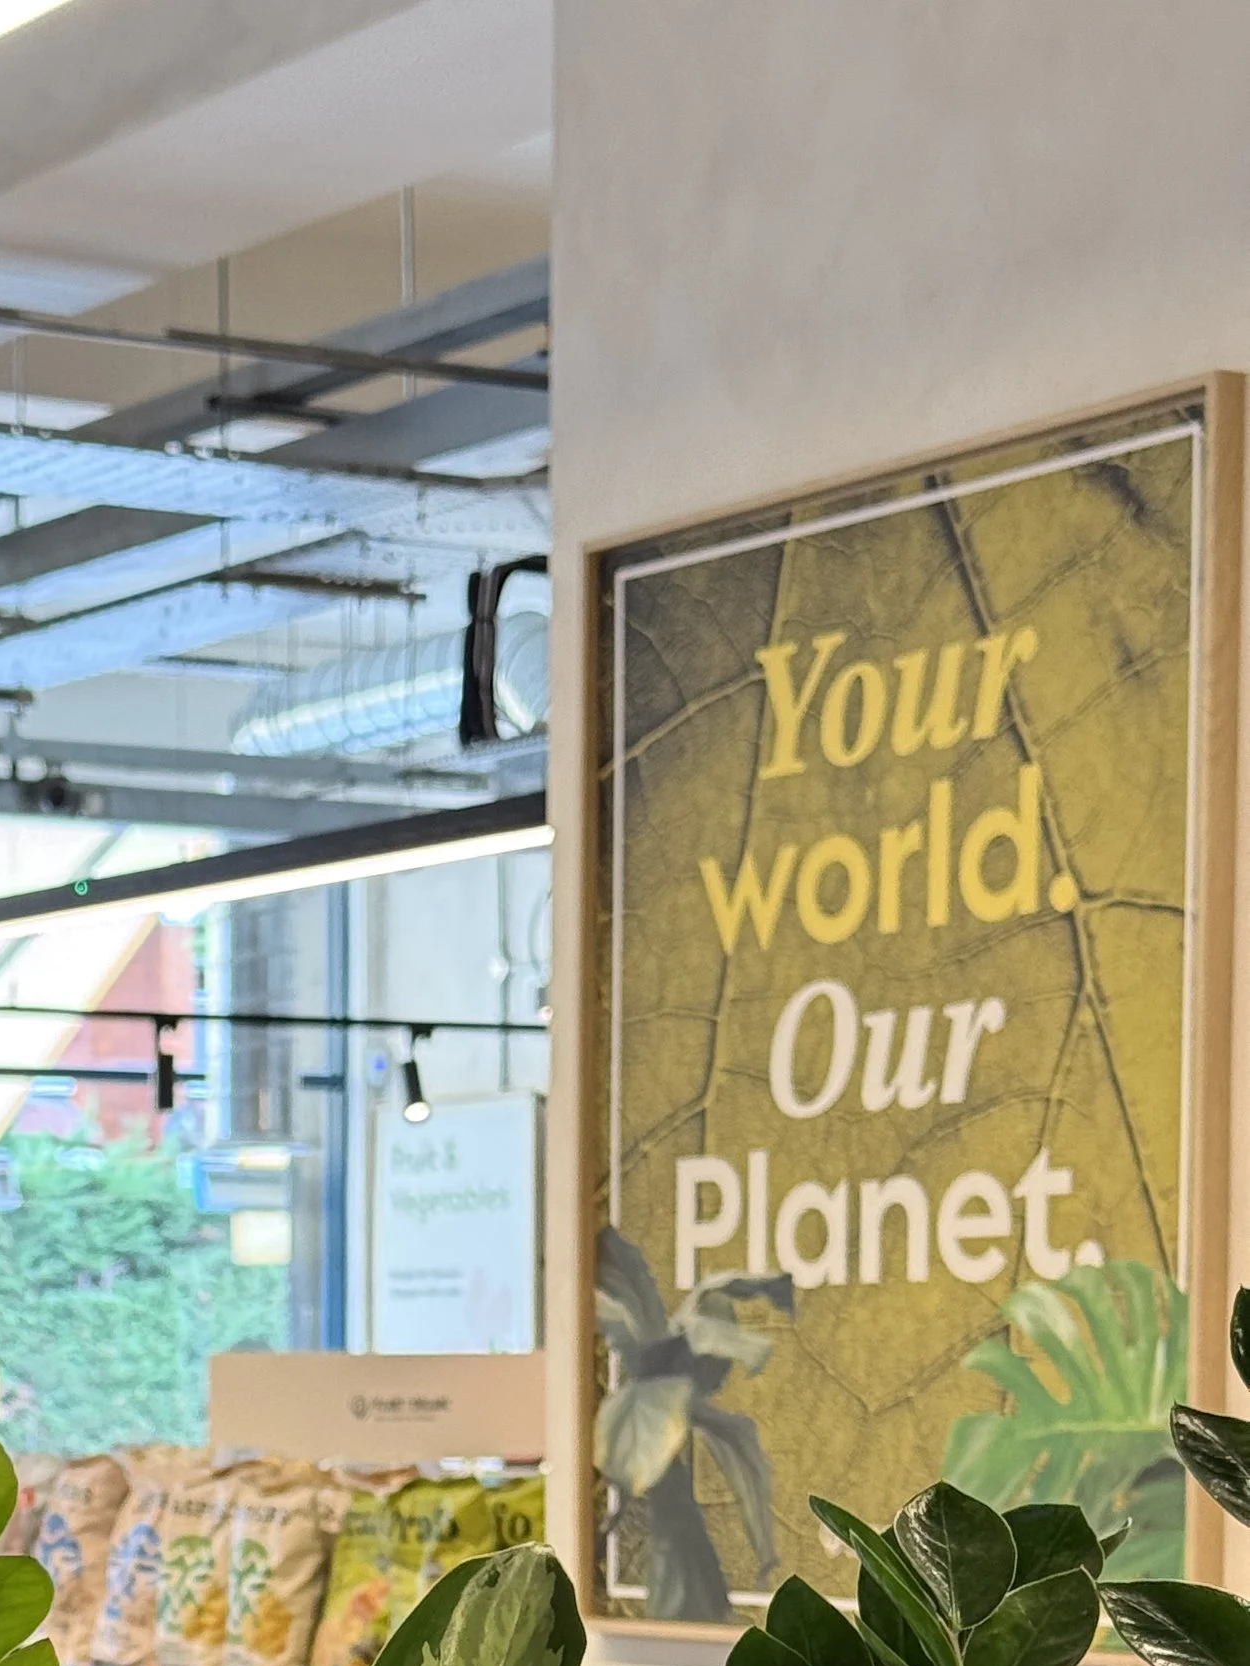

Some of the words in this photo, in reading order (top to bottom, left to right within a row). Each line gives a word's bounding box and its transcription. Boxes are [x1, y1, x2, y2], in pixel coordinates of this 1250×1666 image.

[755, 624, 1039, 780] Your
[698, 762, 1081, 956] world.
[768, 978, 1008, 1120] Our
[674, 1146, 1105, 1291] Planet.
